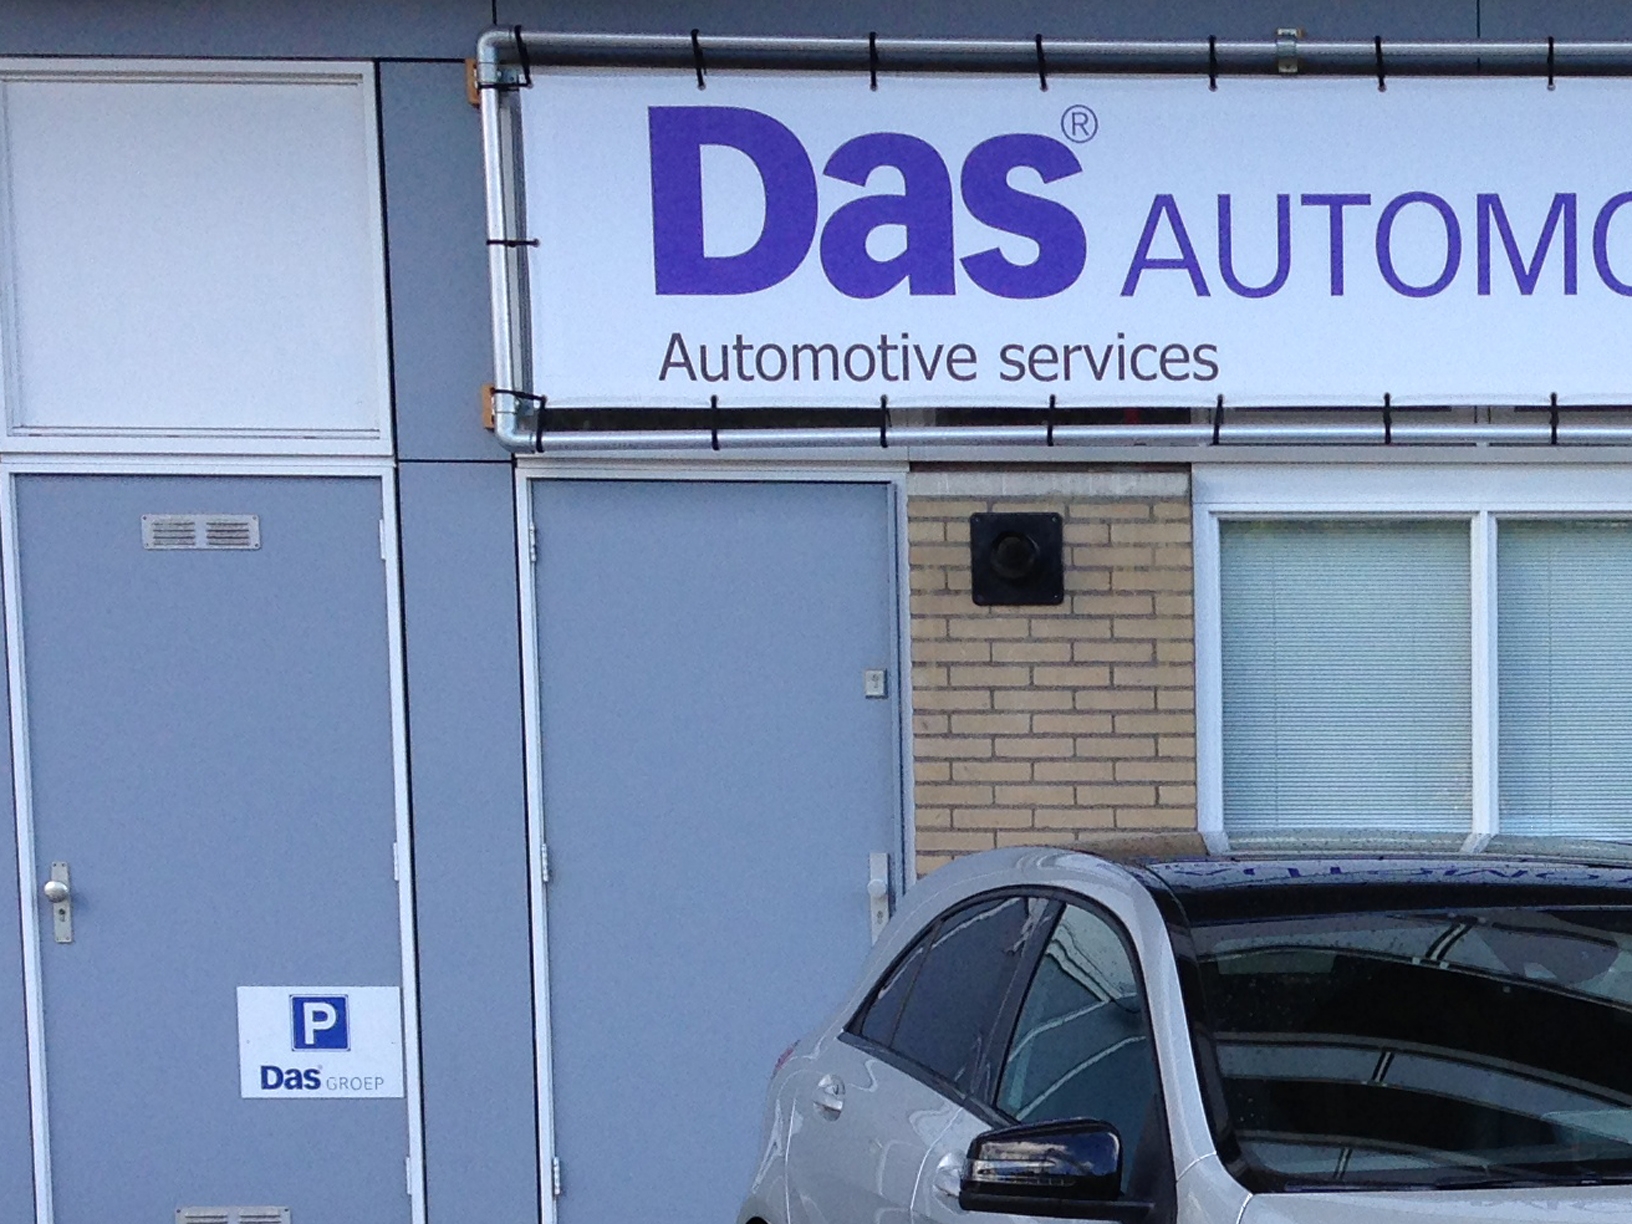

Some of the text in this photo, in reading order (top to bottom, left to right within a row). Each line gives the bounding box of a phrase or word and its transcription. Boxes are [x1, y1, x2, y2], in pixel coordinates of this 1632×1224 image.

[658, 332, 1220, 382] Automotive services
[303, 1001, 337, 1045] P
[260, 1065, 385, 1091] Das GROEP
